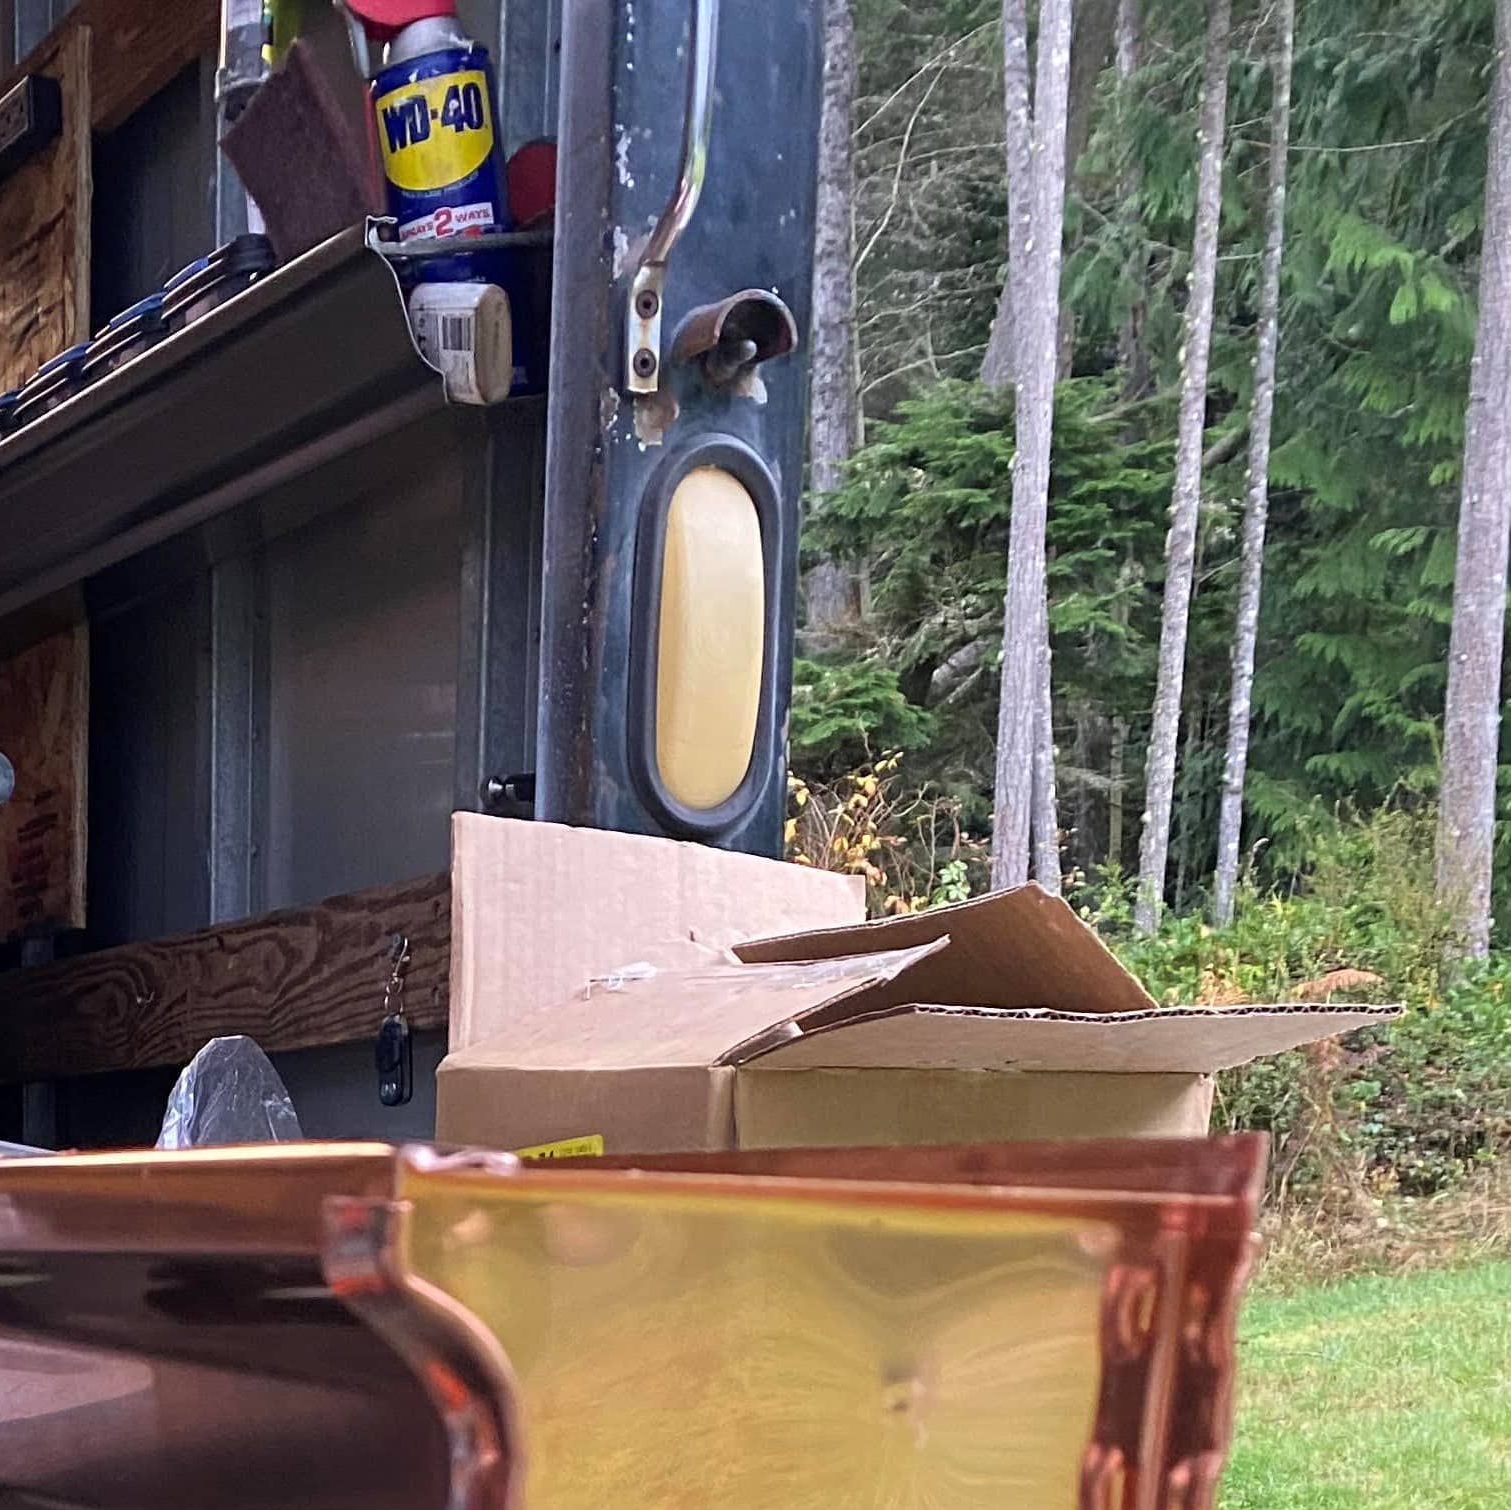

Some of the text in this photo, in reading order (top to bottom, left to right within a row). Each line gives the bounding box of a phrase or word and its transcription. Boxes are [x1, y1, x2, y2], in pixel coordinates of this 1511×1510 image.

[382, 82, 485, 154] WD-40
[433, 208, 454, 237] 2
[455, 208, 491, 223] WAYS
